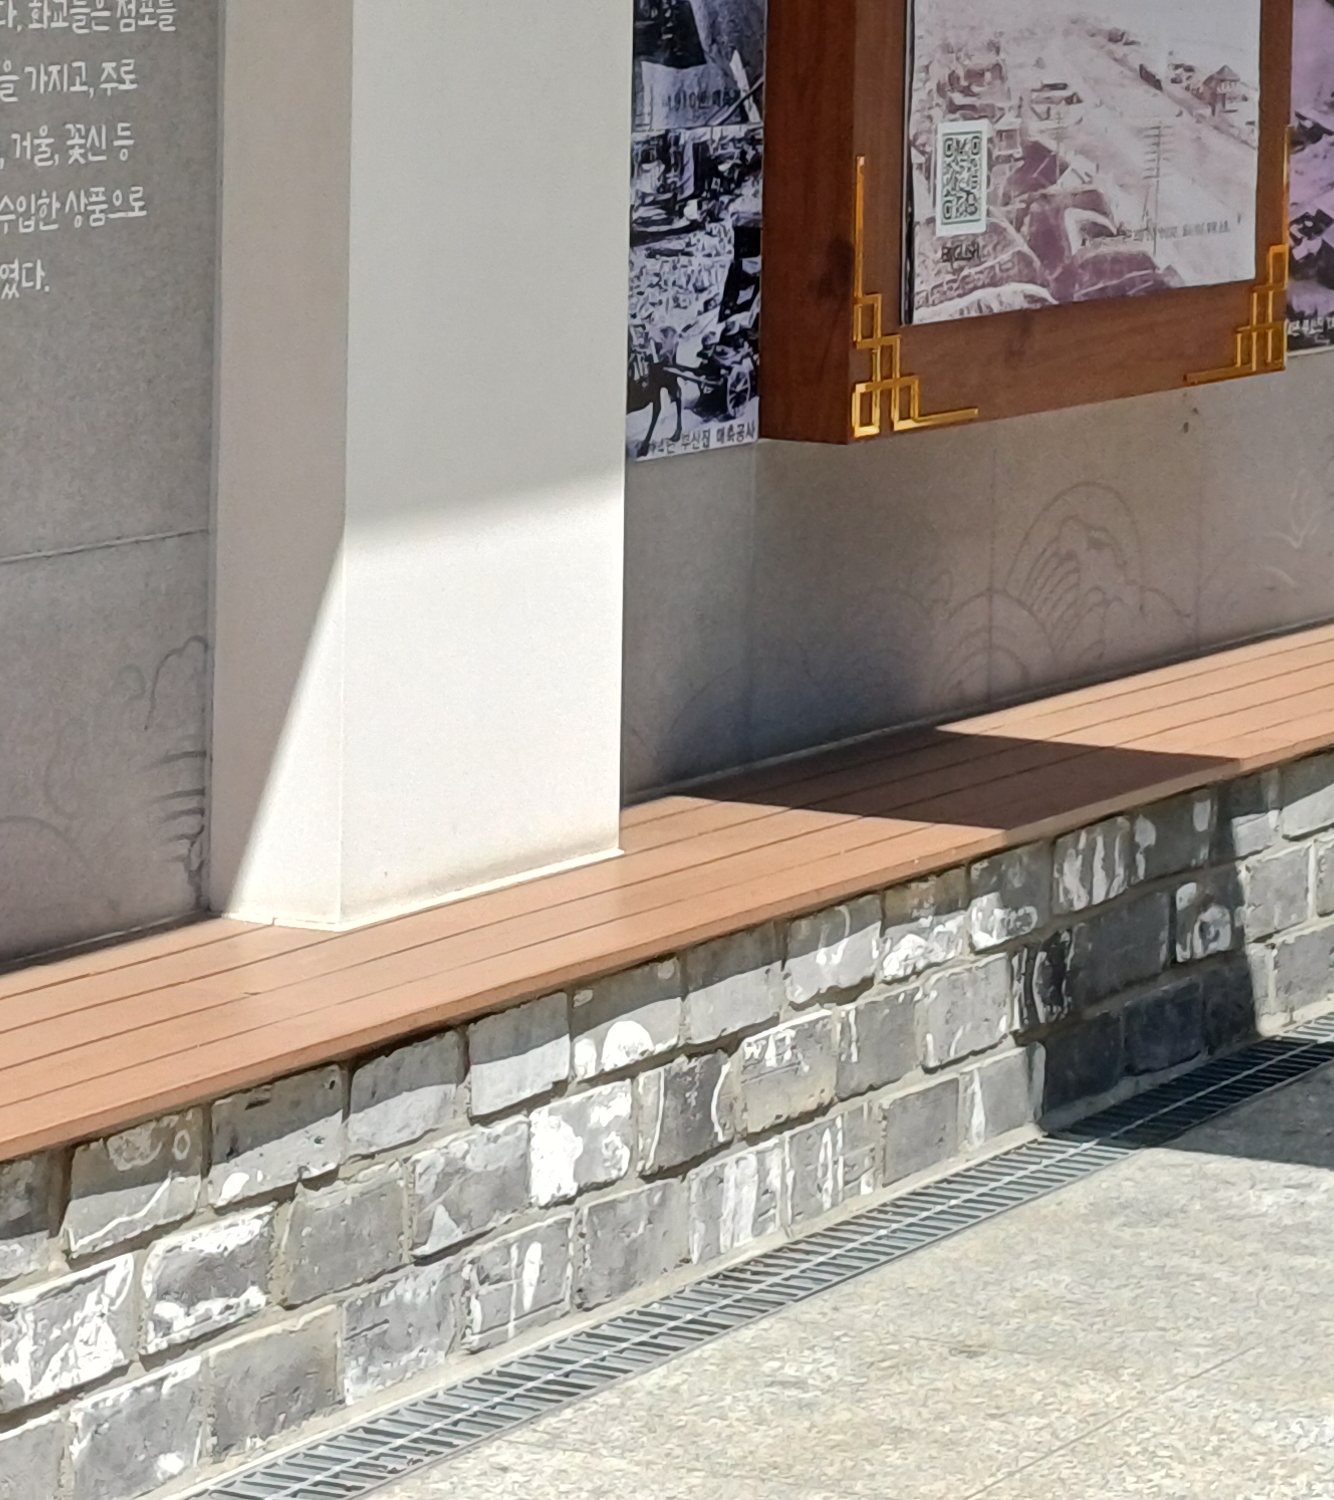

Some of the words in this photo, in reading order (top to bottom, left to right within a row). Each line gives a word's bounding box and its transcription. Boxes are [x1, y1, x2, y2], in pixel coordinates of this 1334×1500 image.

[24, 60, 94, 99] 가지고,
[99, 59, 139, 96] 주로
[11, 125, 59, 168] 거울,
[66, 123, 107, 165] 꽃신
[113, 123, 135, 161] 등
[65, 186, 147, 228] 상품으로
